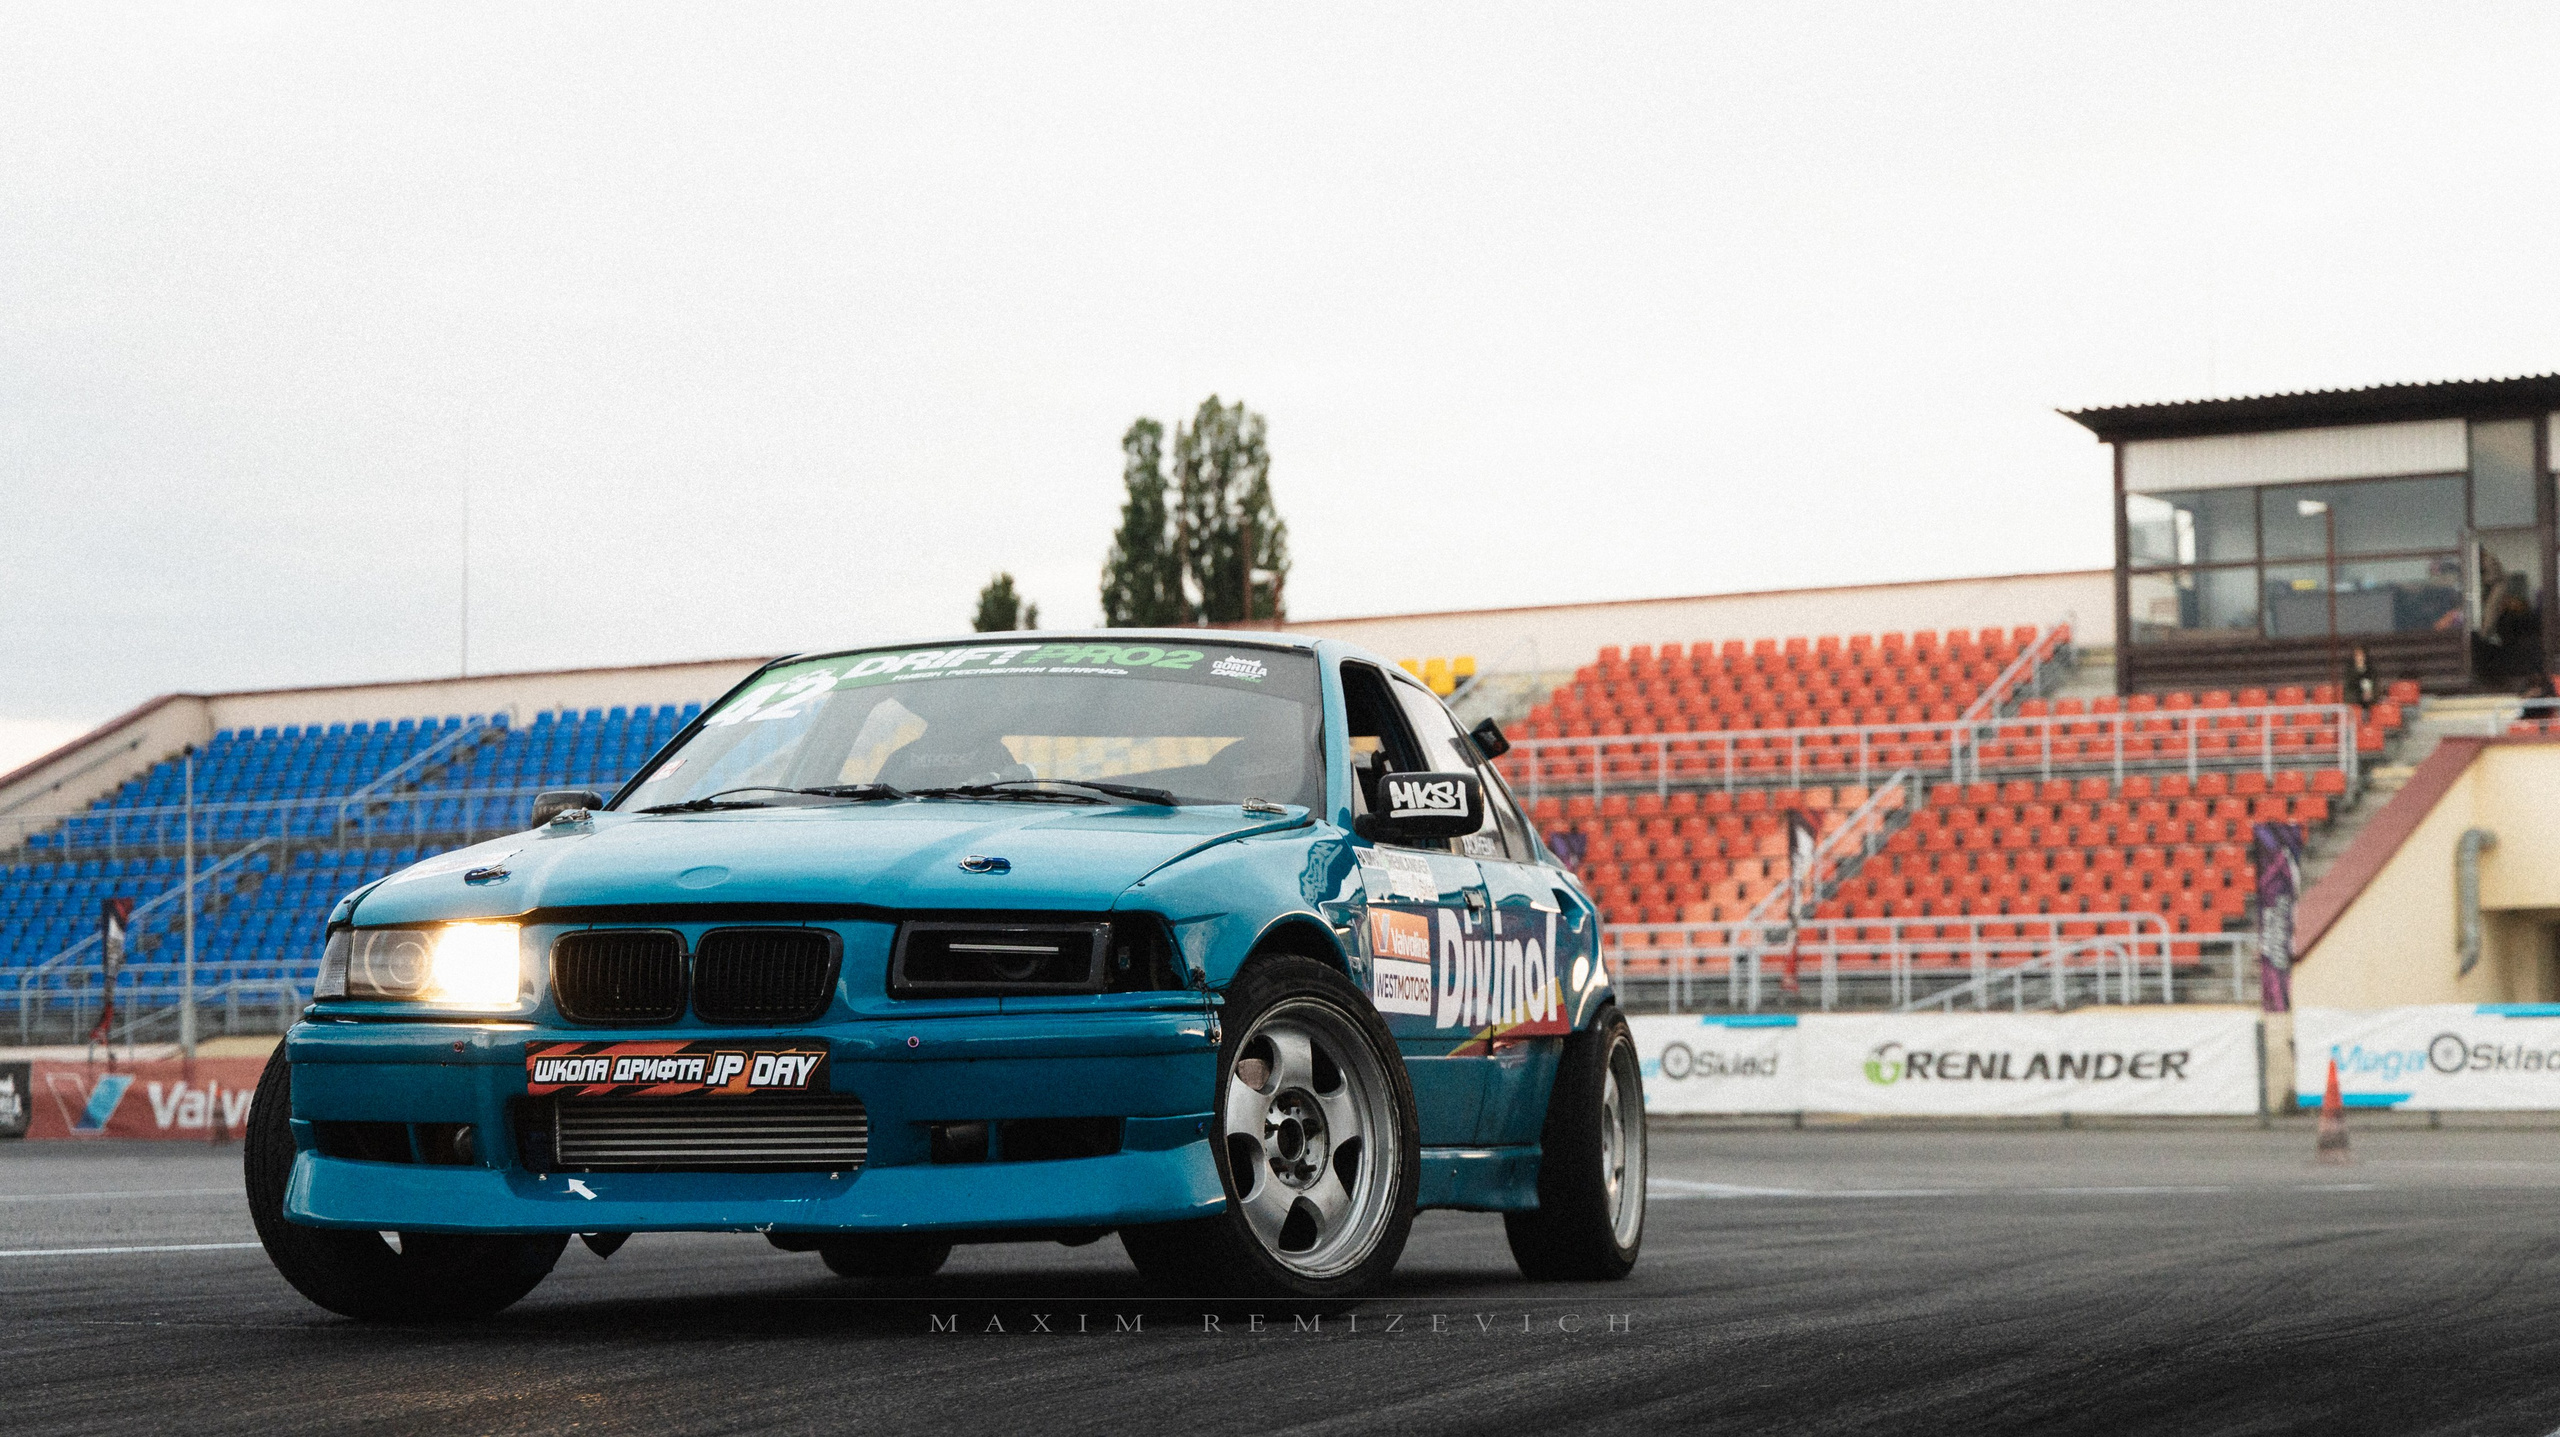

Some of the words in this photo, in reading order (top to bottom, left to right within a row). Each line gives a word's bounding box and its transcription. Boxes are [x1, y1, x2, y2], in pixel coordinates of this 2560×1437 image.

[1048, 666, 1128, 675] БЕЛАРУСЬ
[1212, 661, 1268, 677] GORILLA
[702, 672, 838, 727] 42
[1390, 927, 1430, 959] Valvoline
[1435, 908, 1558, 1029] Divinol
[1376, 972, 1430, 1003] WESTMOTORS
[534, 1055, 607, 1082] ШКОЛА
[613, 1055, 705, 1082] ДРИФТА
[707, 1055, 744, 1085] JP
[750, 1055, 819, 1086] DAY
[1863, 1041, 2190, 1085] GRENLANDER
[147, 1080, 253, 1130] Valv
